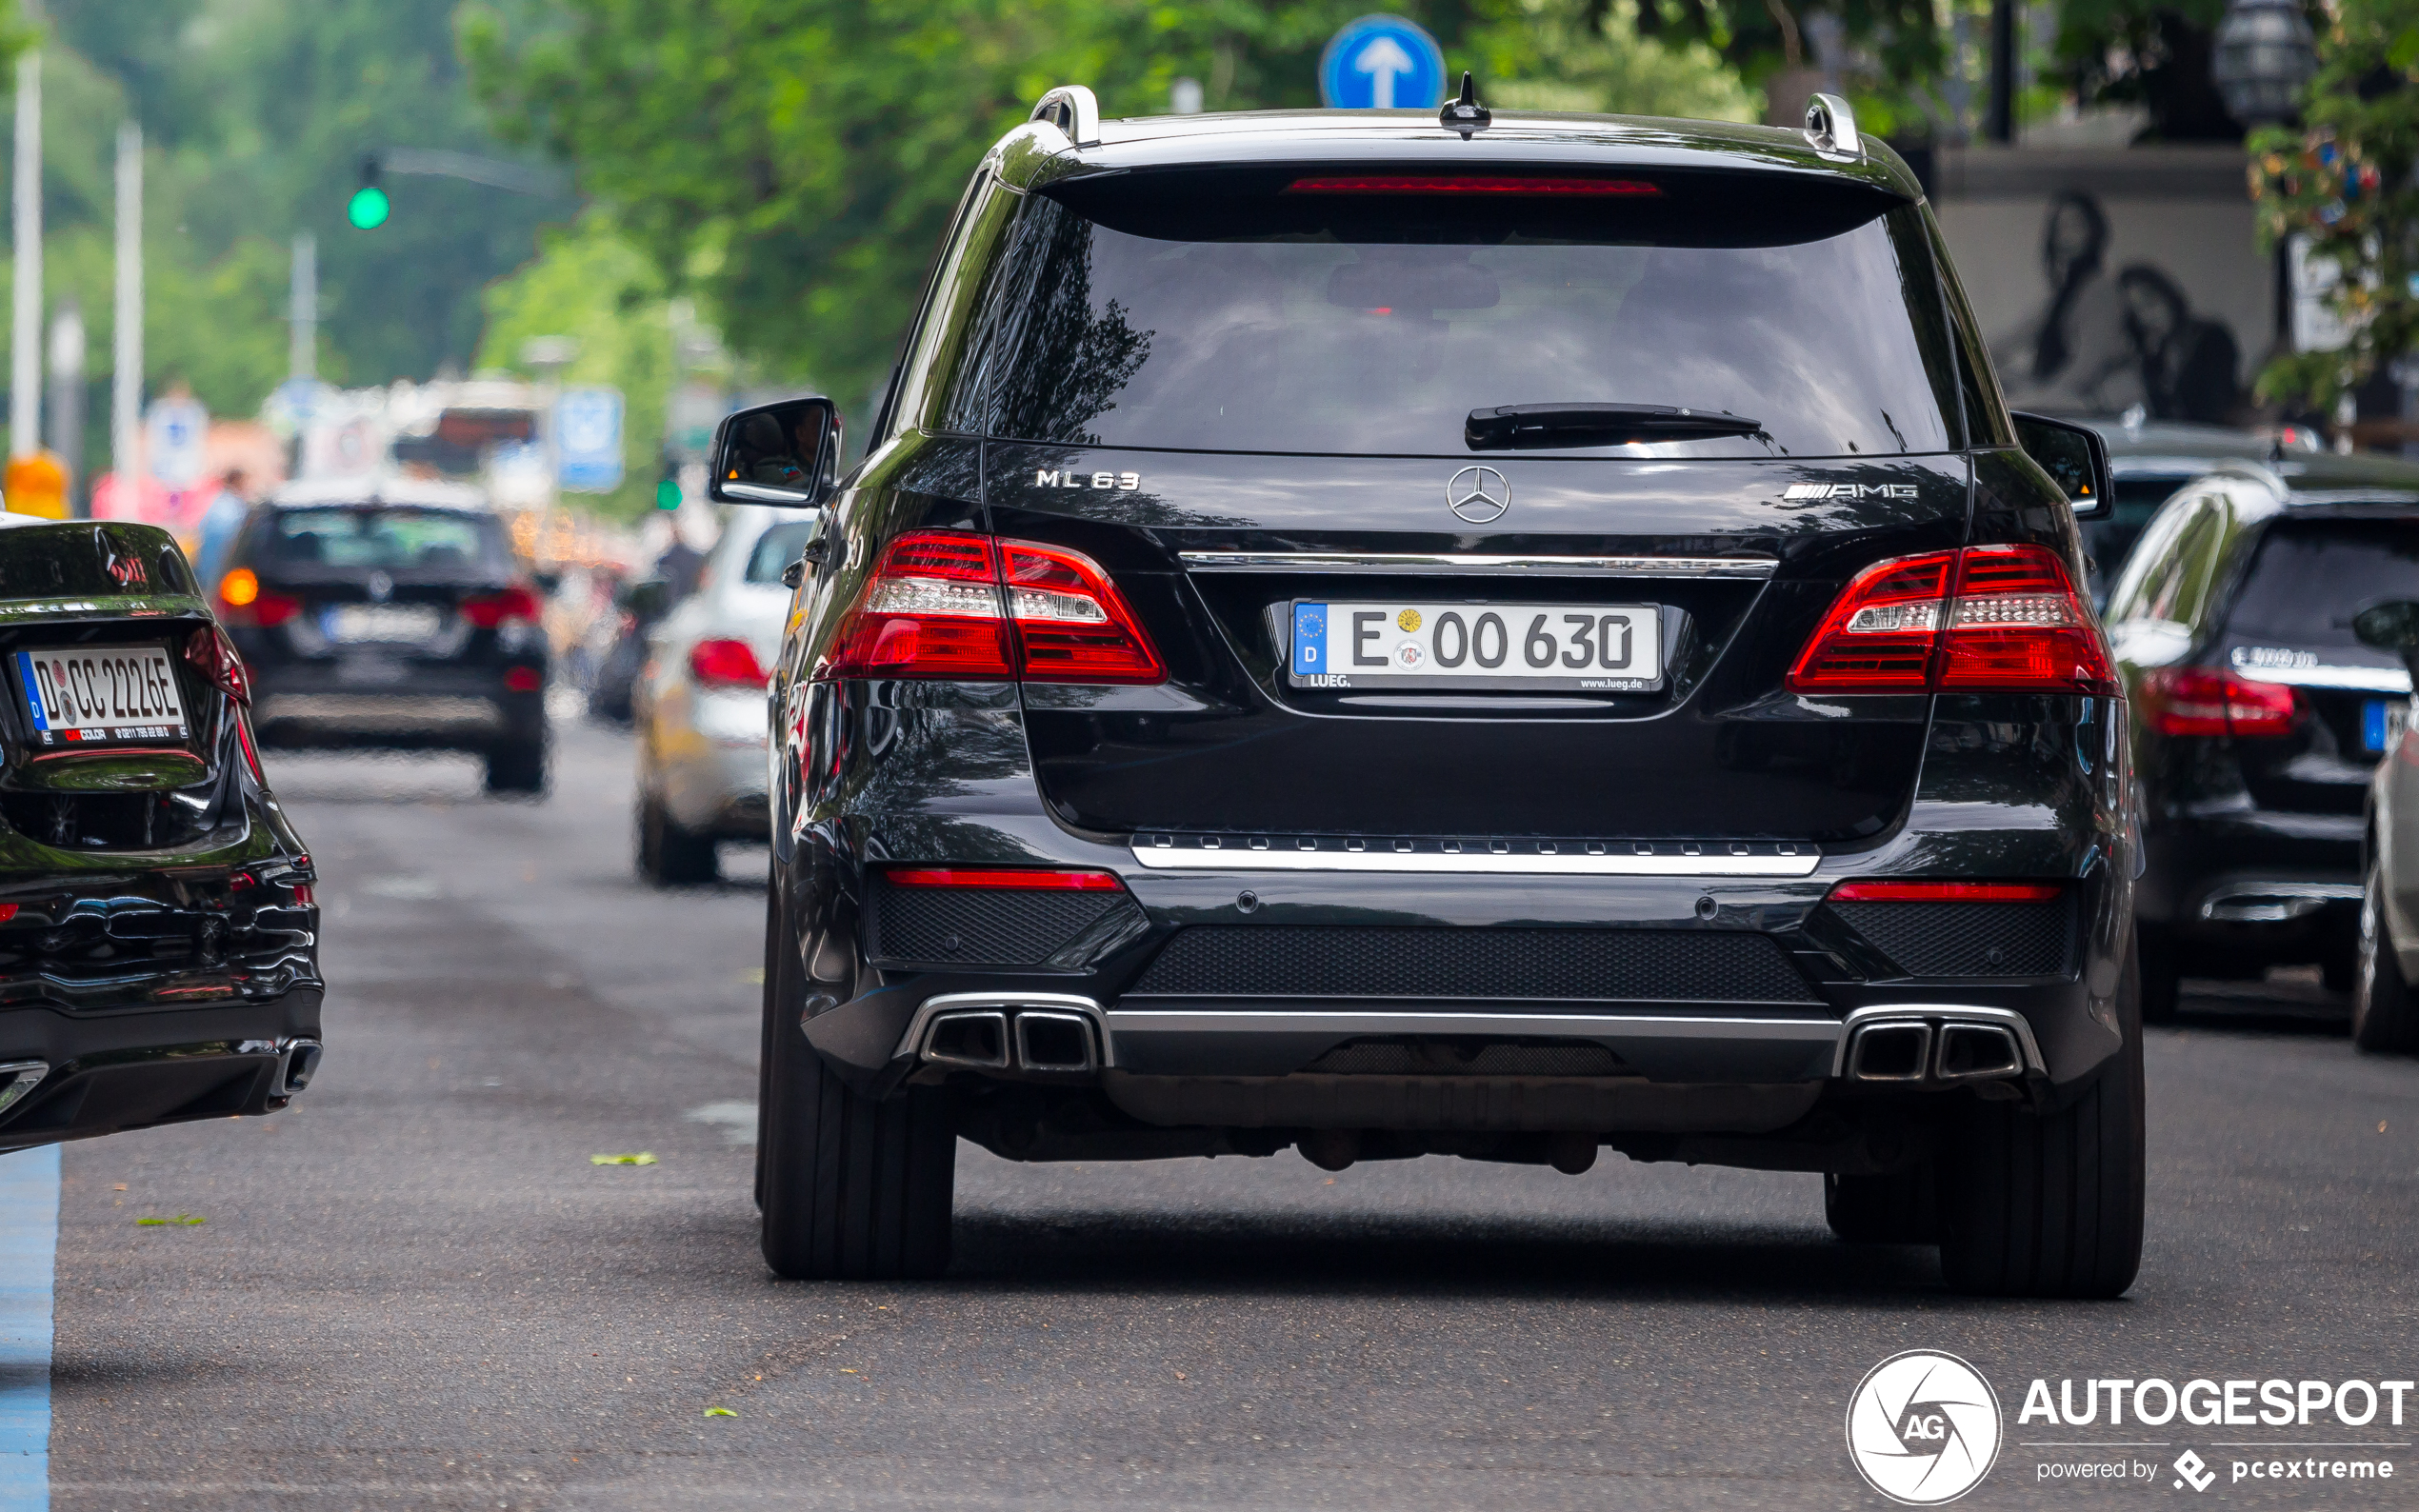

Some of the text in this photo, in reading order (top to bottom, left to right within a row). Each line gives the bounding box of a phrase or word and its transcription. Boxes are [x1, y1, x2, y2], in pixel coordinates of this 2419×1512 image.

[1036, 469, 1141, 491] ML 63
[1353, 611, 1389, 666] E
[1525, 614, 1633, 669] 630
[1304, 647, 1317, 664] D
[34, 657, 179, 721] D CC 2226E
[1310, 674, 1351, 687] LUEG.
[1580, 678, 1644, 690] www.lueg.de
[30, 701, 41, 719] D
